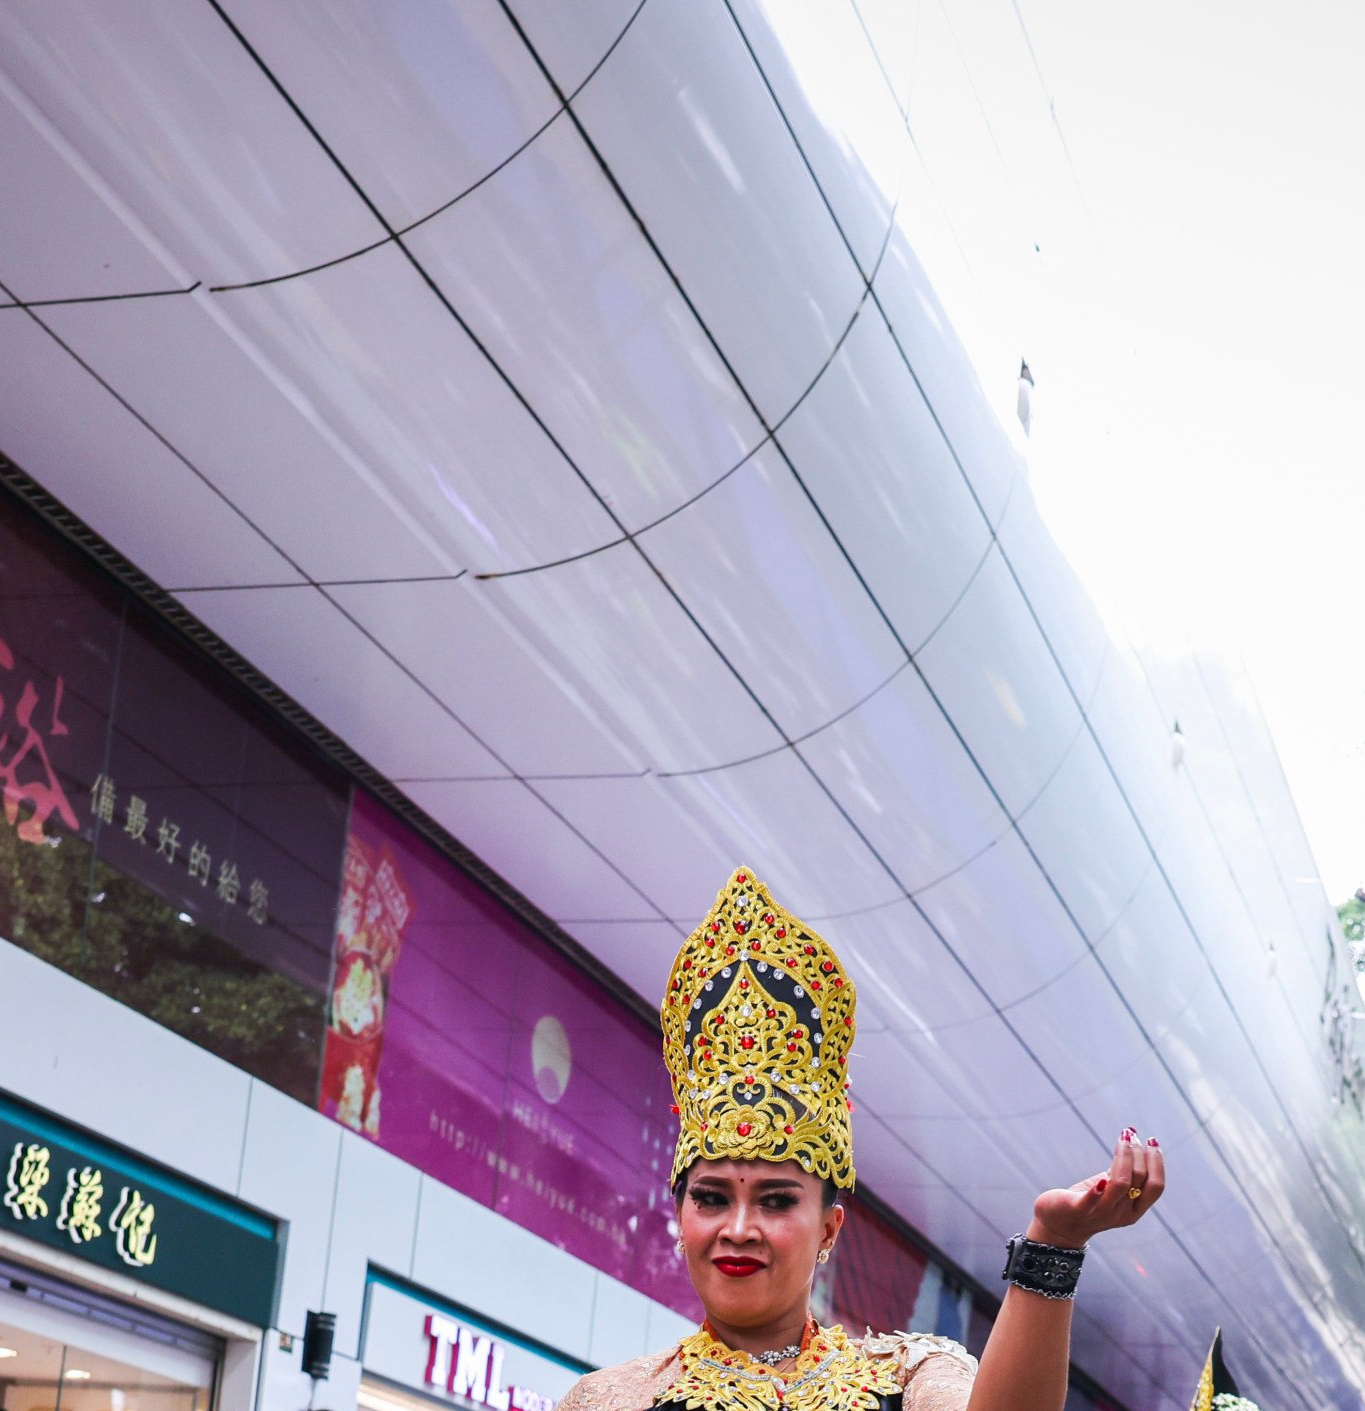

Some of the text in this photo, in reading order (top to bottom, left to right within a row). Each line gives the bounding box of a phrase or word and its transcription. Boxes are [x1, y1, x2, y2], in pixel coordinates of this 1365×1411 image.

[90, 773, 270, 925] 備最好的給您
[425, 1315, 511, 1411] TML
